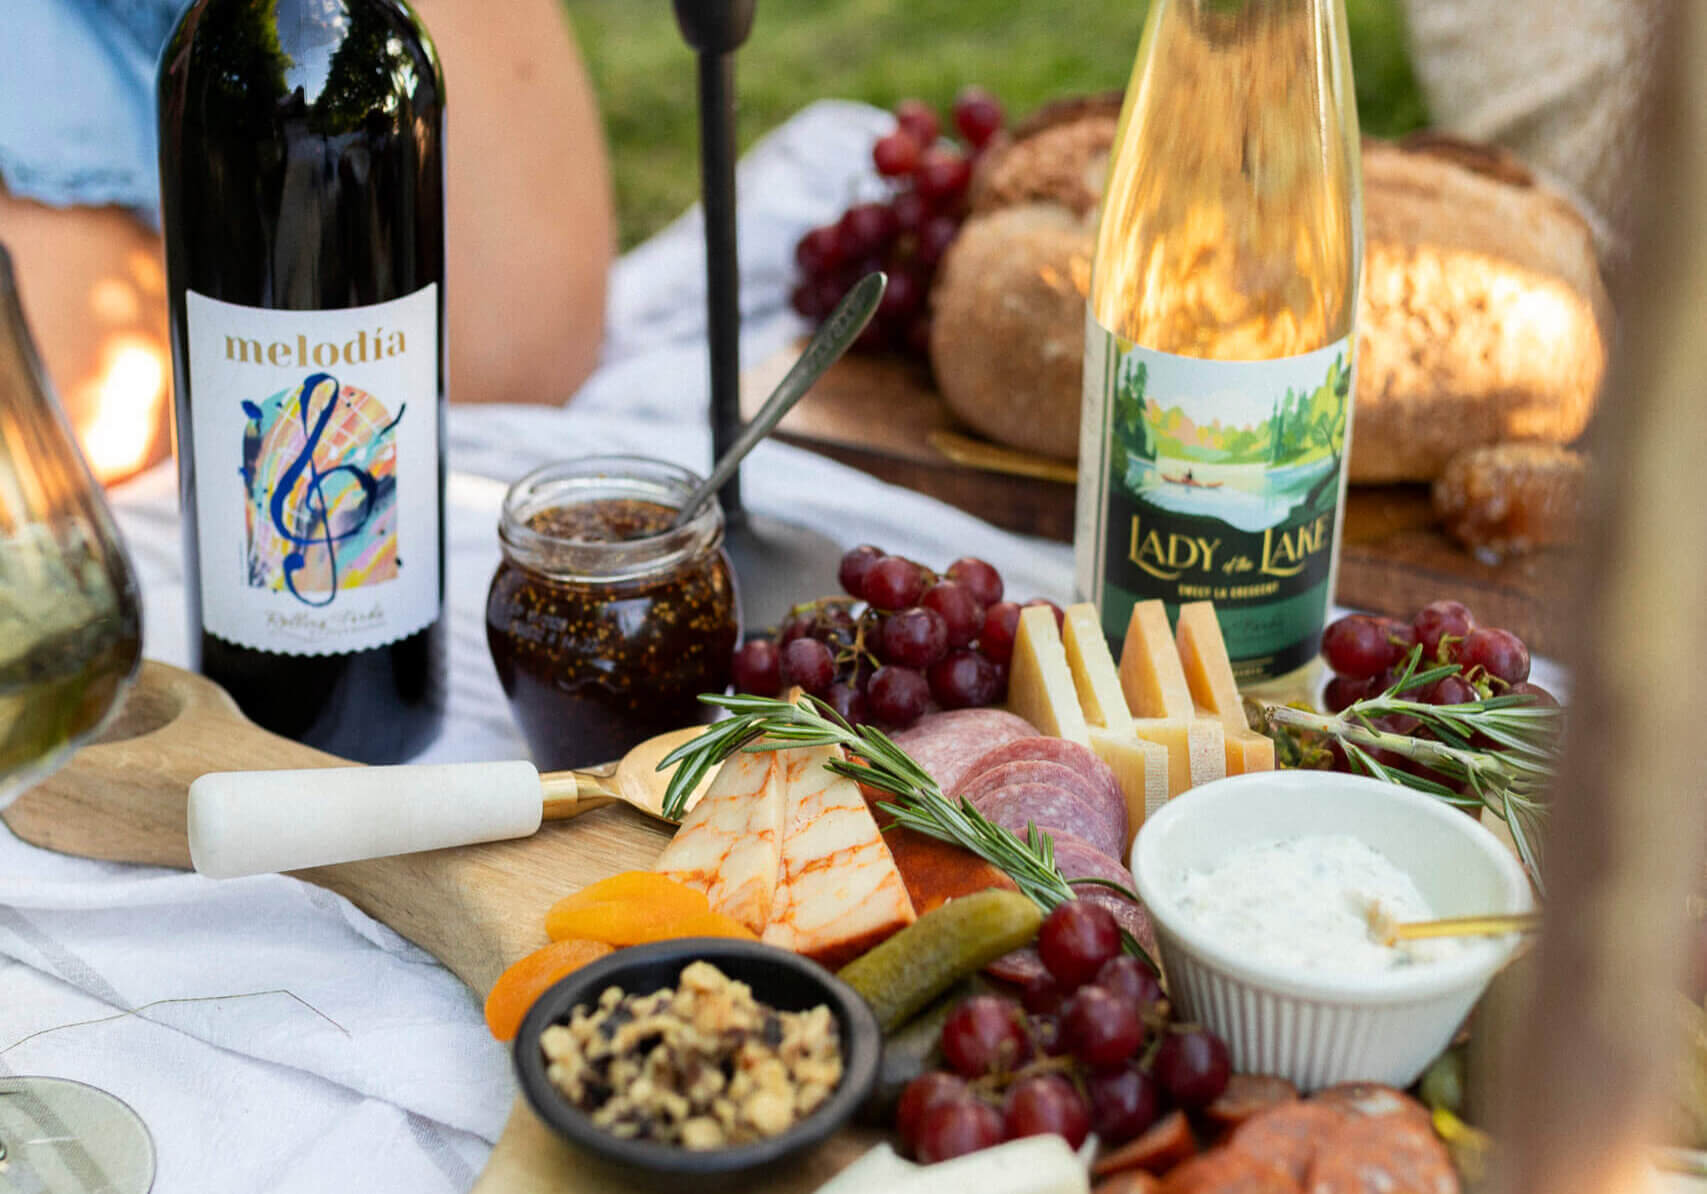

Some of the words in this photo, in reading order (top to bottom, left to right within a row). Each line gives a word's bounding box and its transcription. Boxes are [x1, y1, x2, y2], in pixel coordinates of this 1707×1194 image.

[224, 327, 406, 368] melodía
[1129, 514, 1222, 580] LADY
[1259, 514, 1328, 577] LAKE
